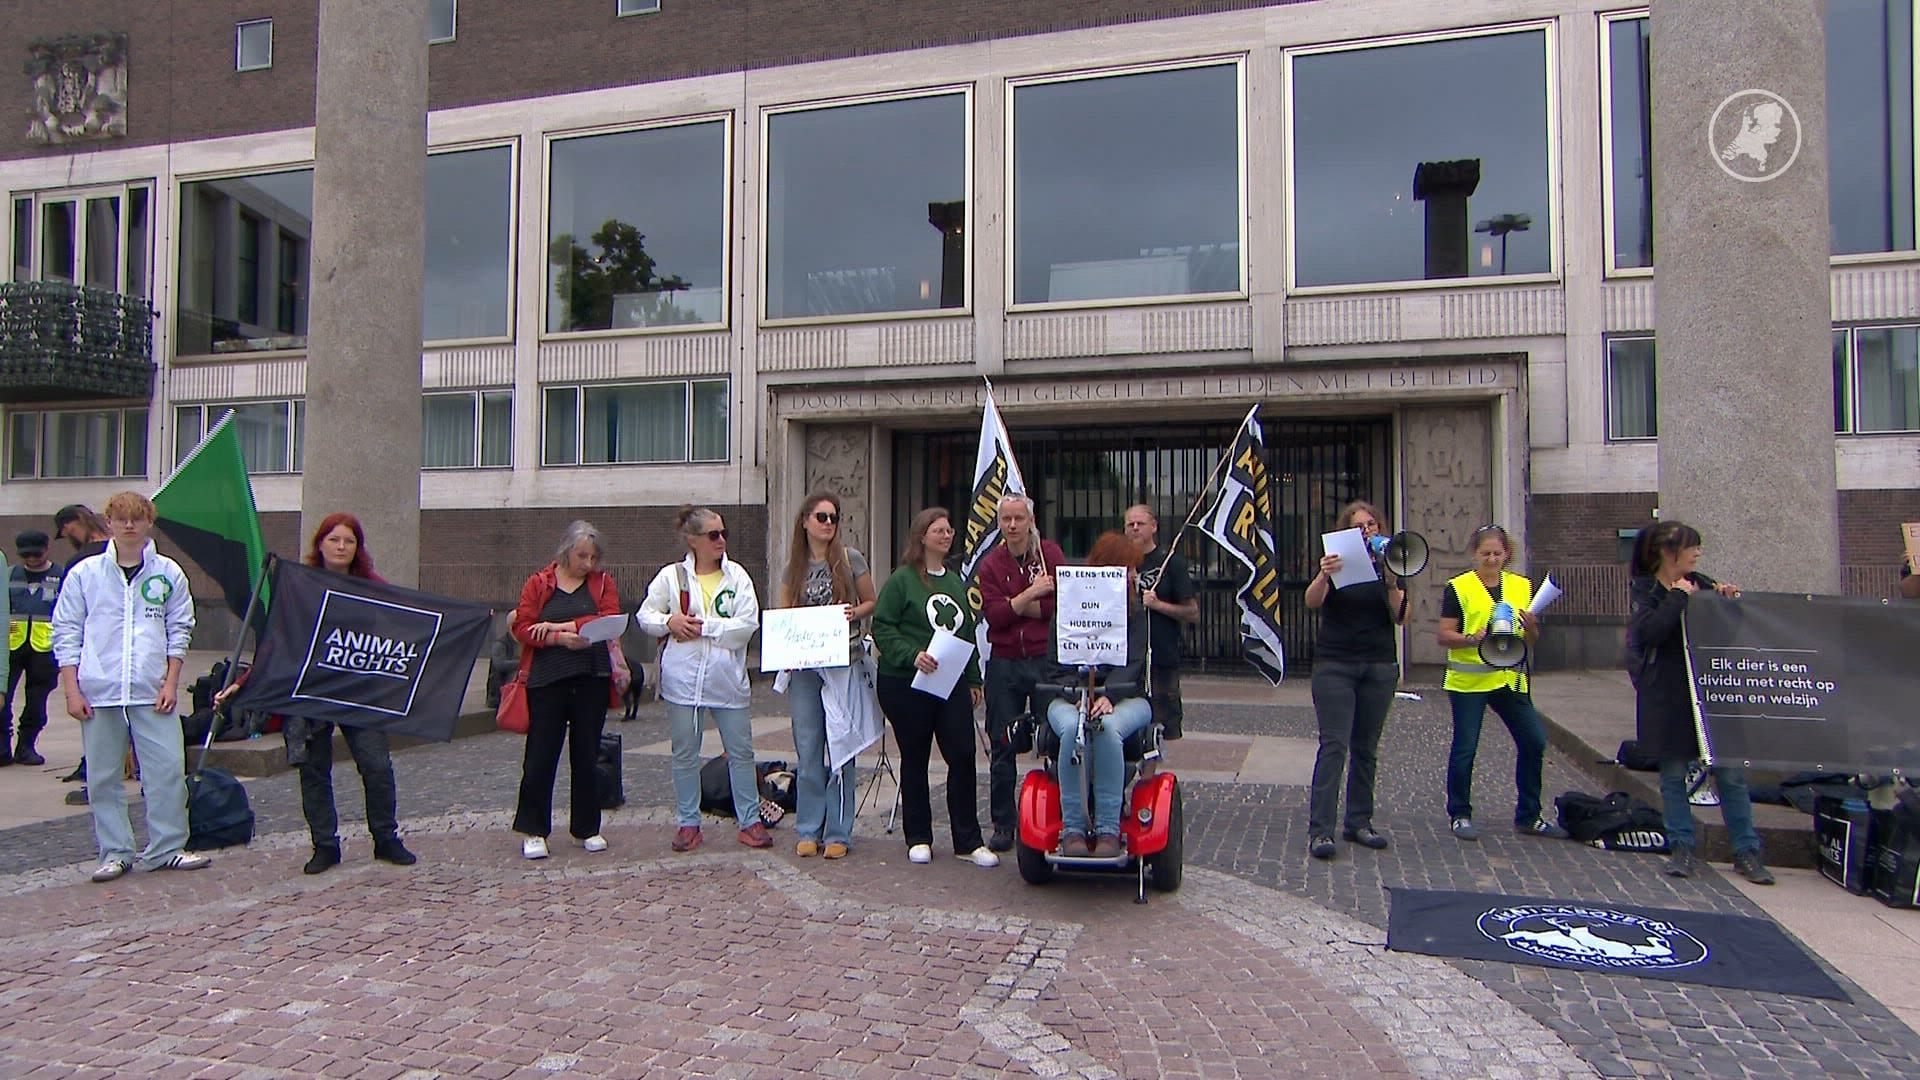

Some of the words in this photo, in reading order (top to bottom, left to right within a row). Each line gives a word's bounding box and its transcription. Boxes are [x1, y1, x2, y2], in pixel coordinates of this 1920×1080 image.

[791, 393, 850, 410] DOOR
[1202, 375, 1304, 395] LEIDEN
[1315, 372, 1375, 389] MET
[1389, 367, 1497, 387] BELEID
[1058, 570, 1071, 578] HO
[1069, 620, 1112, 628] HUBERTUS
[325, 627, 418, 658] ANIMAL
[326, 646, 410, 673] RIGHTS
[1710, 658, 1732, 670] Elk
[1736, 659, 1765, 671] dier
[1767, 660, 1779, 672] is
[1782, 664, 1807, 673] een
[1697, 674, 1741, 687] dividu
[1746, 676, 1774, 688] met
[1779, 677, 1813, 690] recht
[1816, 682, 1835, 693] op
[1705, 690, 1743, 703] leven
[1748, 694, 1766, 704] en
[1770, 693, 1819, 708] welzijn
